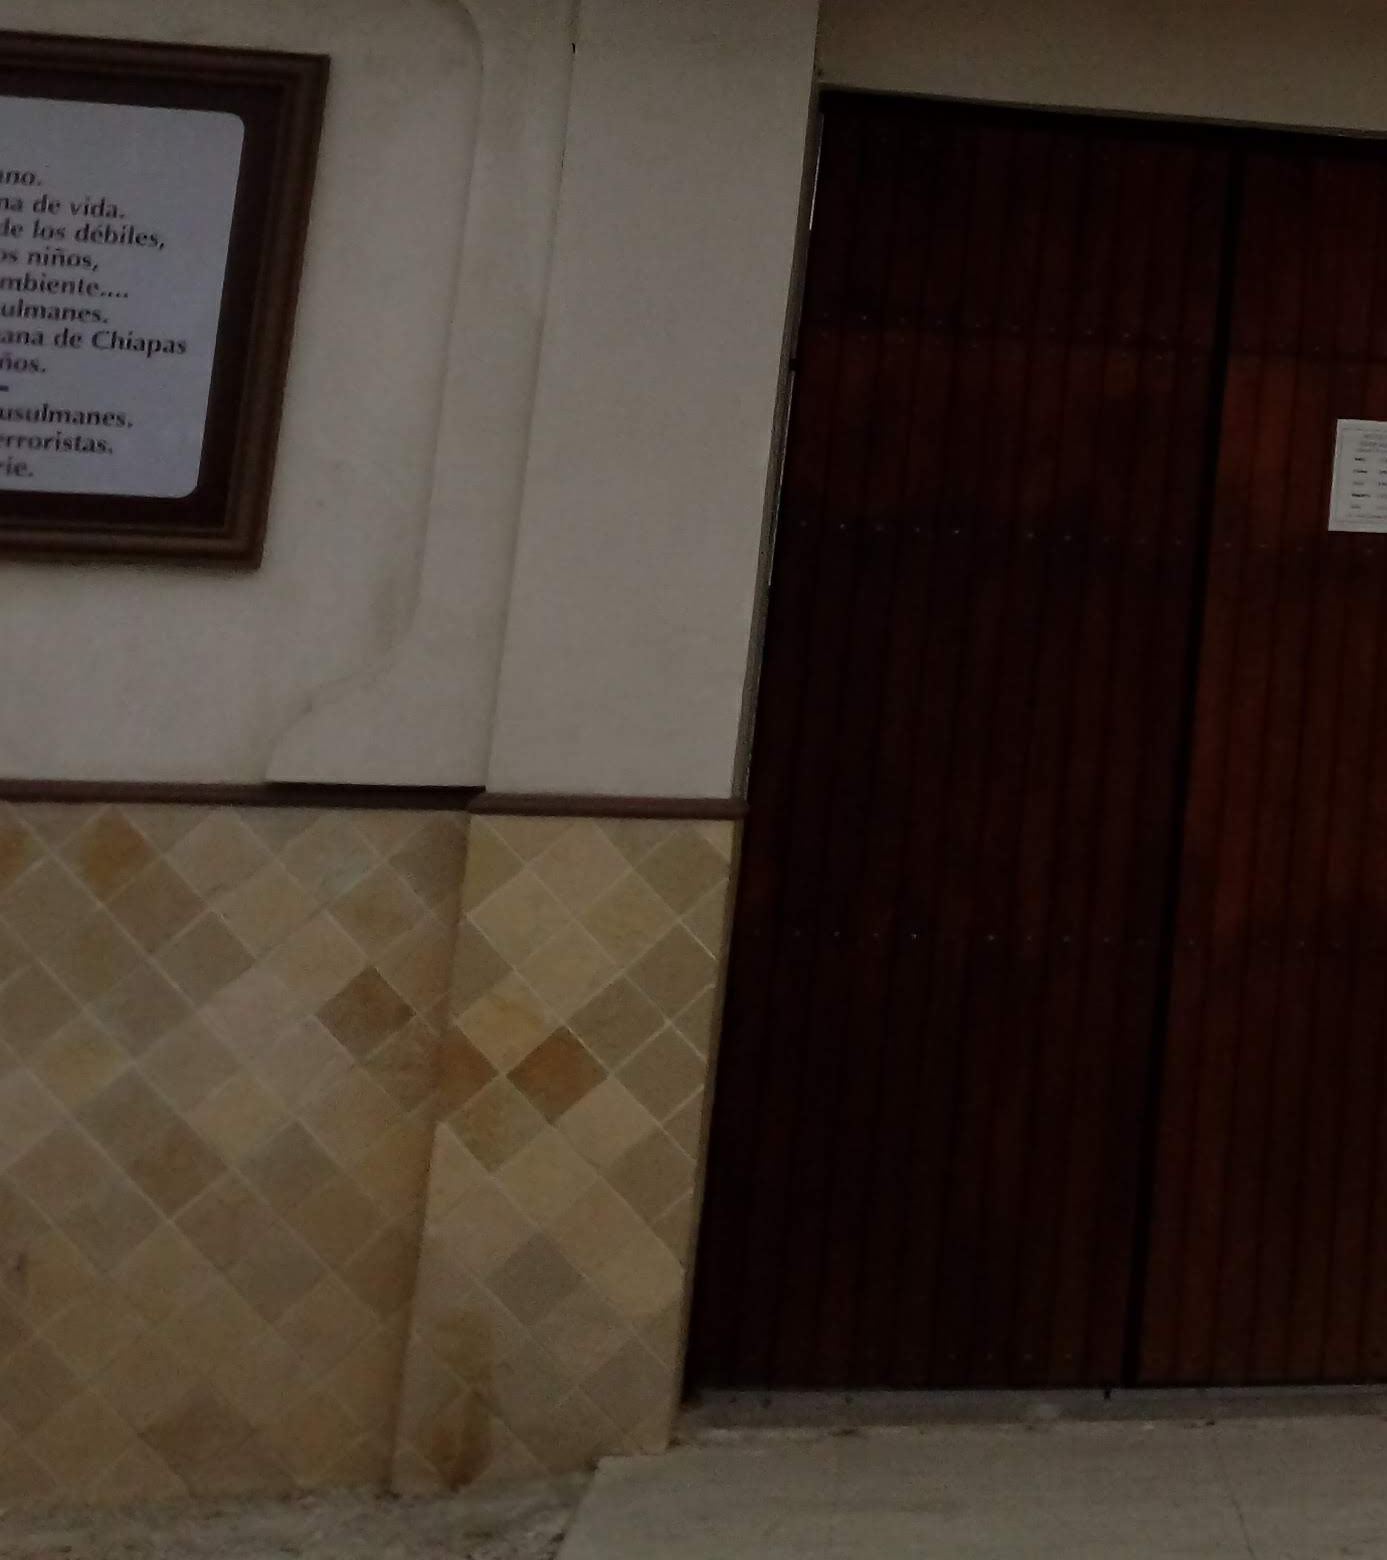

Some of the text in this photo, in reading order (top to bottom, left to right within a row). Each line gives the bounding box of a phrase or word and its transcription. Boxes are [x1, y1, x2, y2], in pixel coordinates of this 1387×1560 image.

[33, 194, 61, 216] de
[70, 195, 126, 219] vida.
[33, 219, 66, 241] los
[75, 223, 166, 251] débiles,
[27, 247, 100, 272] niños,
[54, 328, 83, 349] de
[92, 329, 188, 358] Chiapas
